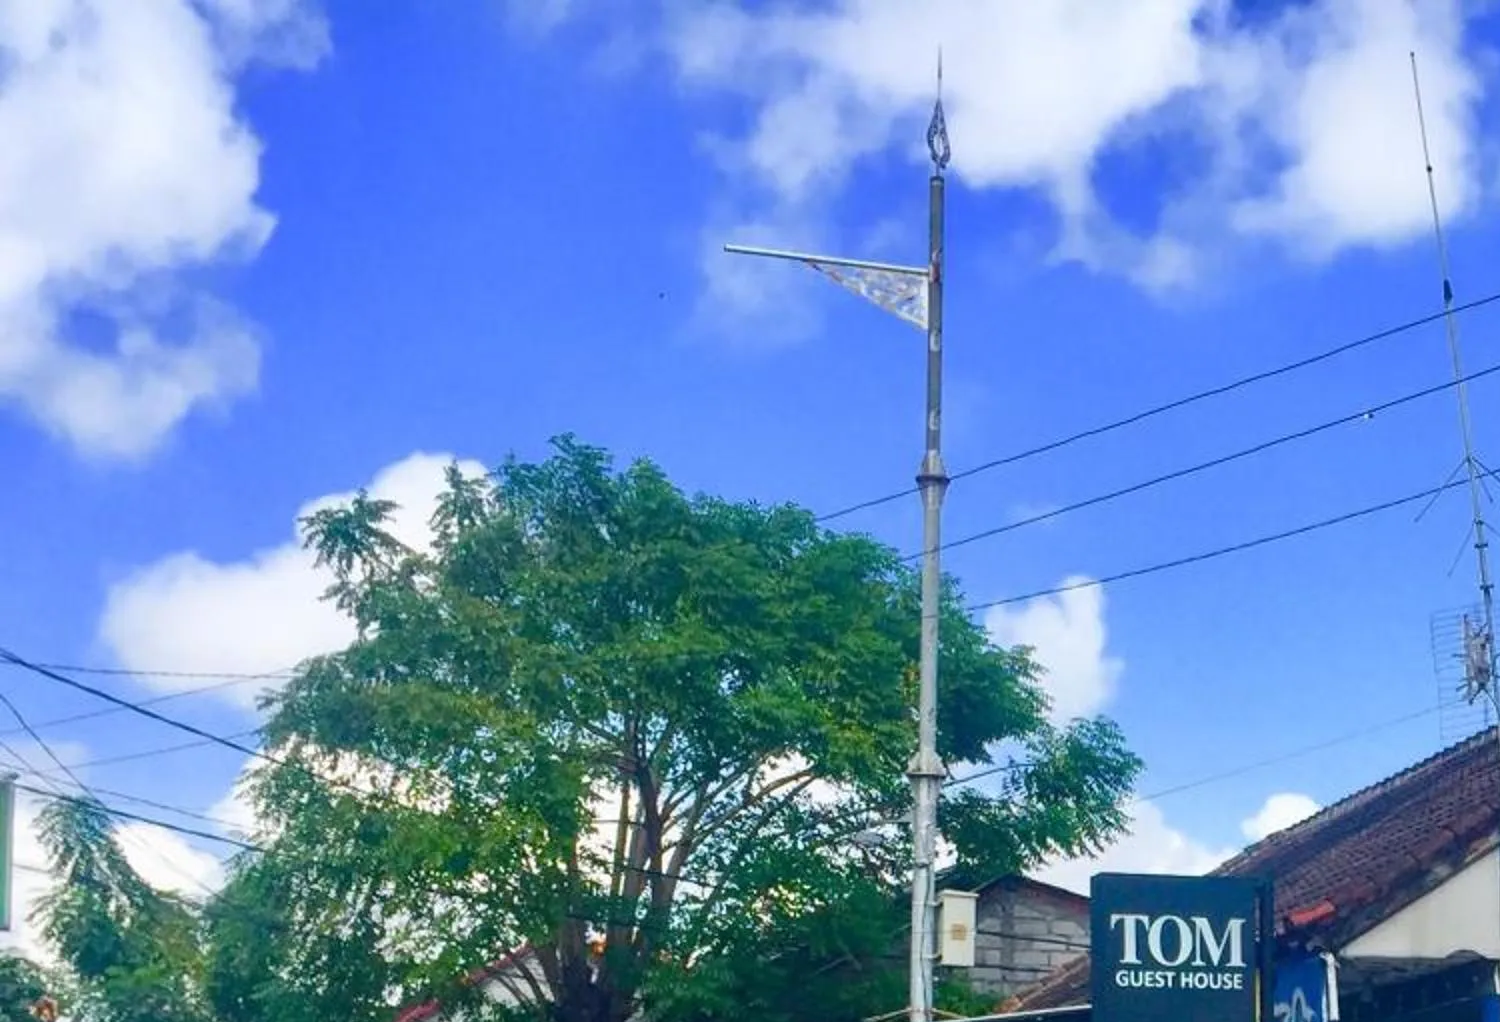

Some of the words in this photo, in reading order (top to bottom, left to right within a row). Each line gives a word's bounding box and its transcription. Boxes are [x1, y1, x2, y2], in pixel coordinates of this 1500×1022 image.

[1110, 913, 1247, 967] TOM
[1115, 969, 1176, 988] GUEST
[1180, 971, 1244, 990] HOUSE
